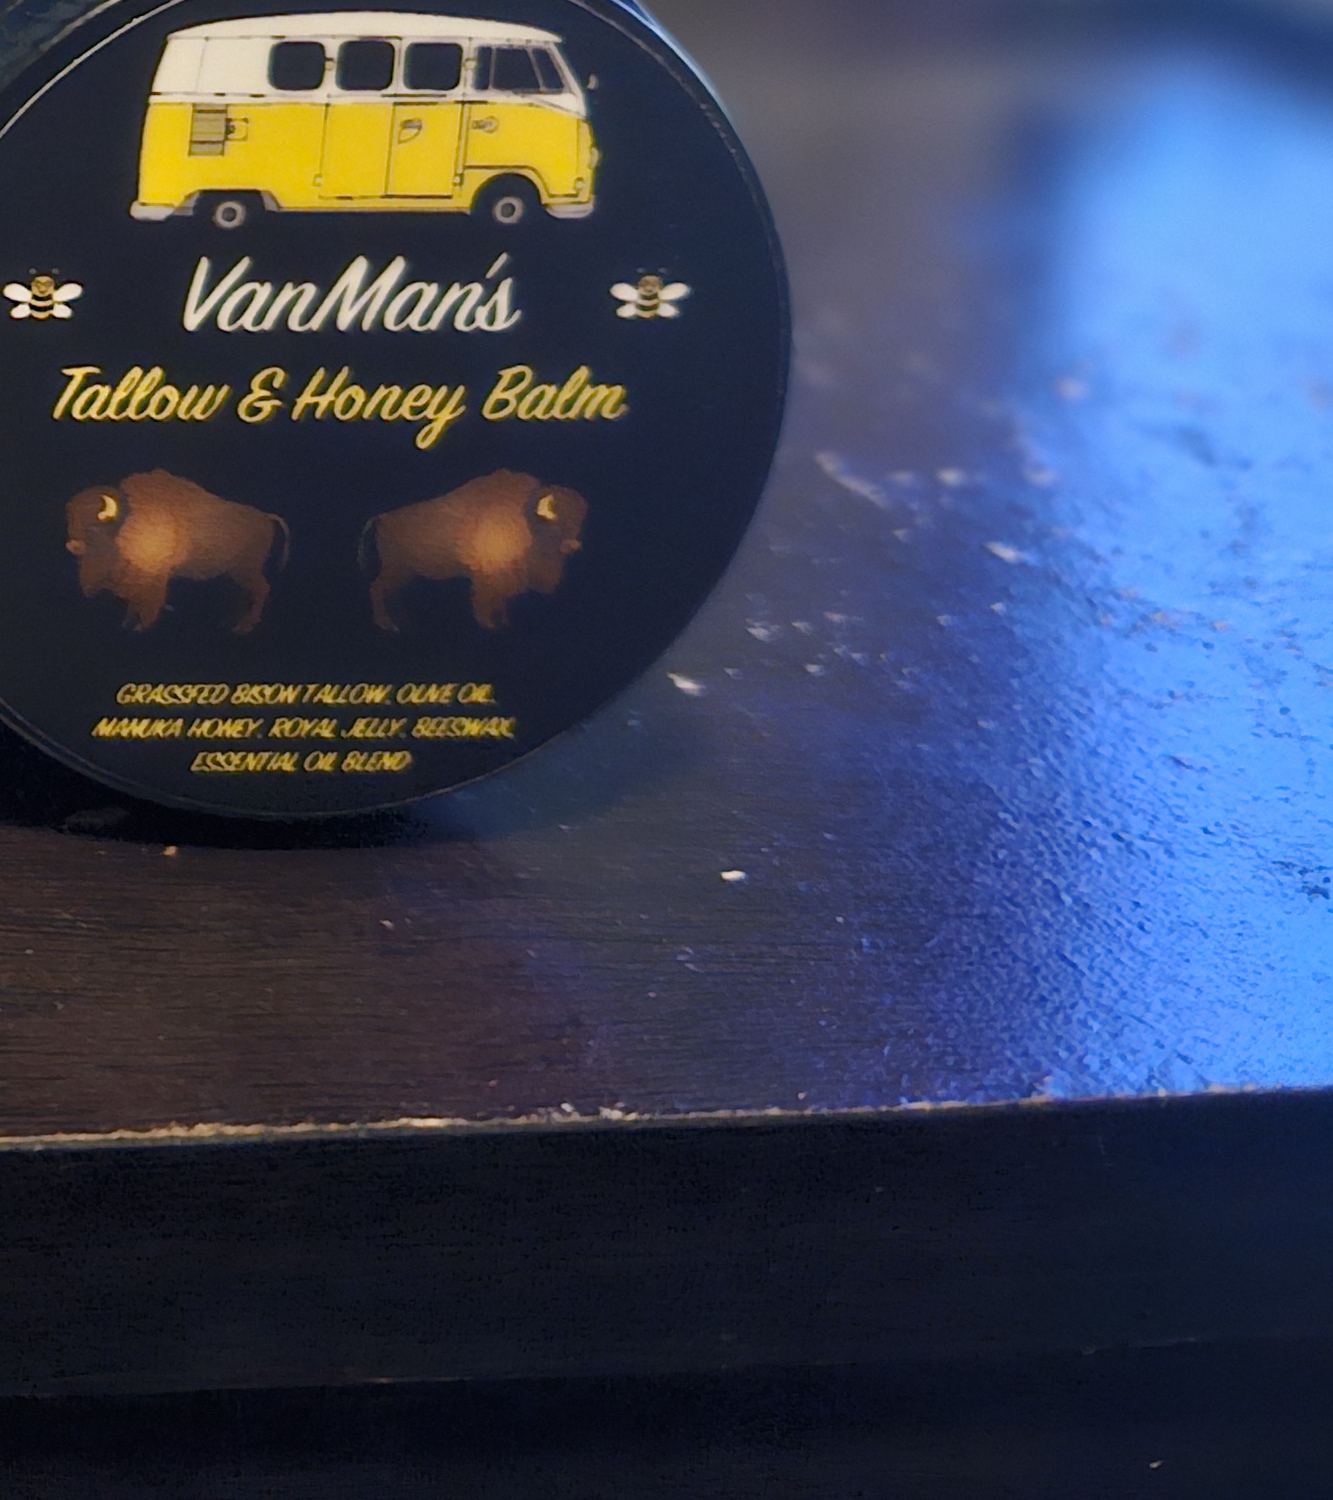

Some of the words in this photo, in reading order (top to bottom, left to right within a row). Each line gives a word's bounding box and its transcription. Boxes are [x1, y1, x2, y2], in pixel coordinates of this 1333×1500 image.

[181, 253, 523, 333] VanMan's
[52, 365, 229, 422] Tallow
[239, 367, 285, 423] &
[293, 366, 466, 449] Honey
[482, 365, 628, 422] Balm
[116, 683, 231, 705] GRASSFED
[232, 683, 302, 705] BISON
[396, 683, 458, 705] OLIVE
[91, 718, 183, 739] MANUKA
[267, 717, 337, 739] ROYAL
[190, 751, 300, 773] ESSENTIAL
[303, 751, 338, 772] OIL
[341, 751, 413, 773] BLEND
